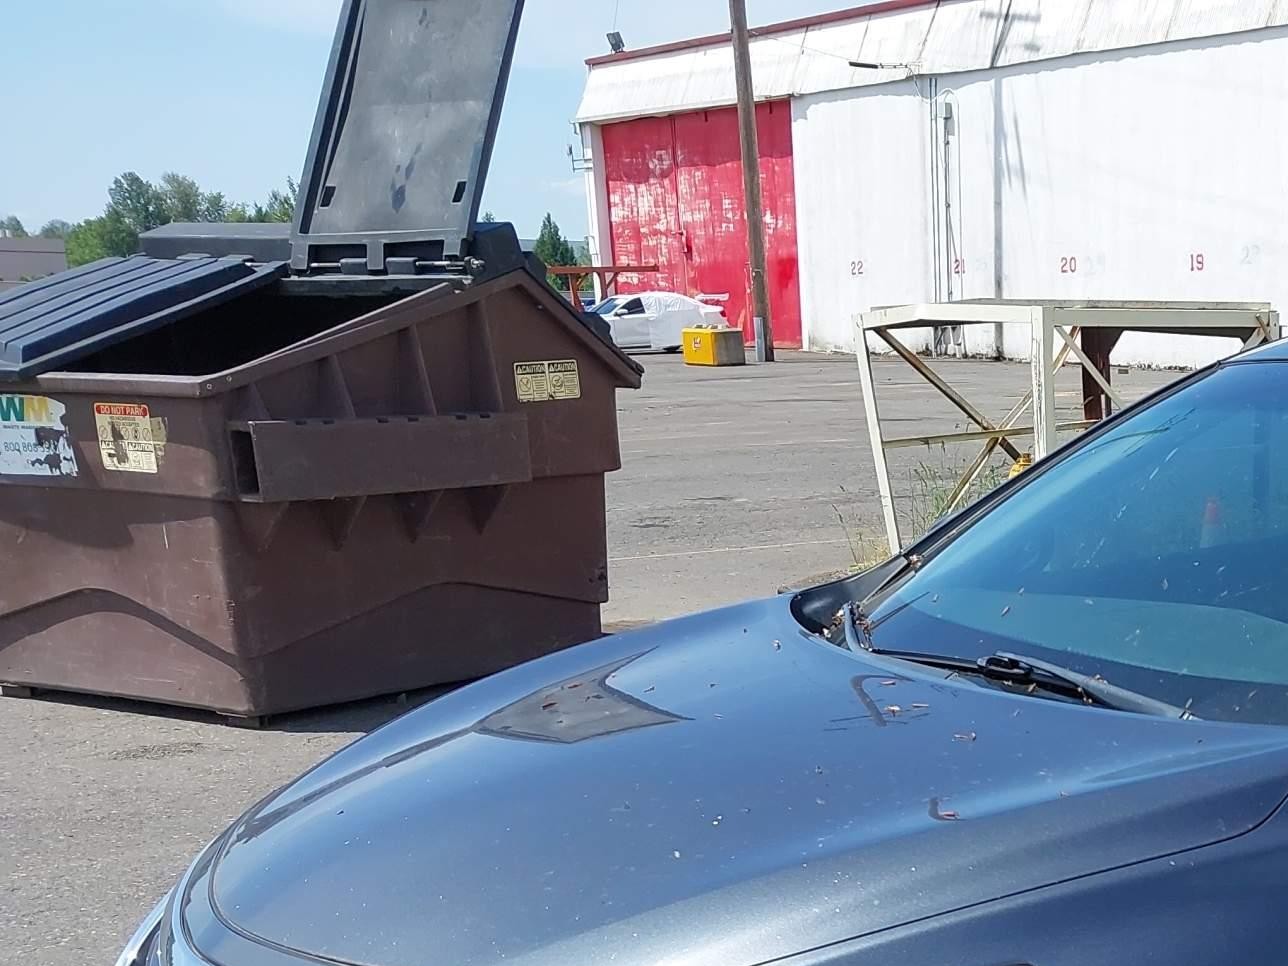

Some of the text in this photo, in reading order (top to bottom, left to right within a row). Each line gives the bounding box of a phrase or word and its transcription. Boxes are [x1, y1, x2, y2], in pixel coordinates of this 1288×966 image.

[851, 261, 864, 275] 22
[1060, 256, 1077, 273] 20
[1190, 253, 1204, 272] 19
[0, 396, 49, 422] WM
[100, 405, 144, 416] DO NOT PARK
[4, 441, 20, 452] 800
